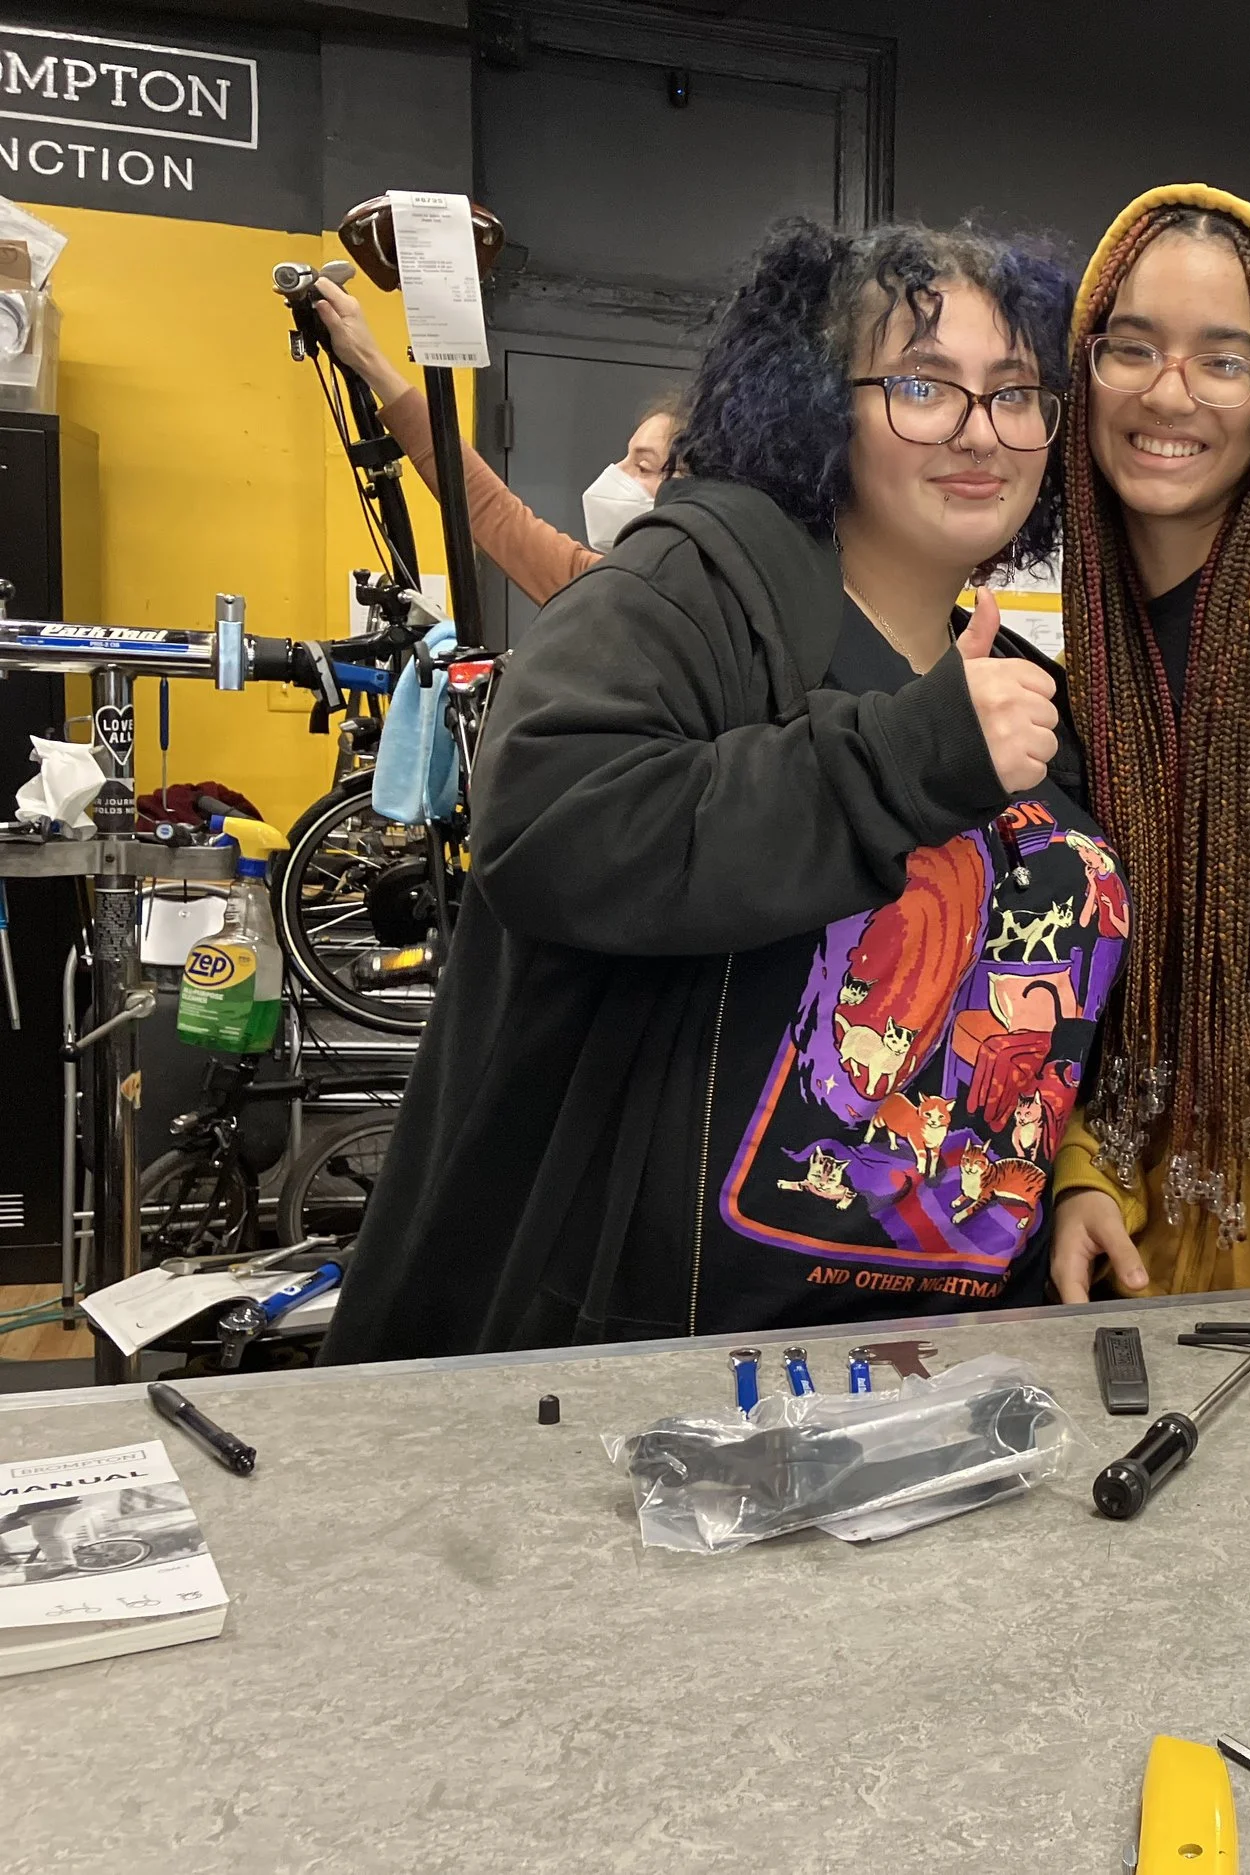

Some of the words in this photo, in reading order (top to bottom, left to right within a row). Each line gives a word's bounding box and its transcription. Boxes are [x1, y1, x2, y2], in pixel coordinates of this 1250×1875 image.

[0, 50, 231, 120] MPTON
[40, 624, 107, 639] Park
[108, 628, 168, 642] Tool
[103, 719, 133, 731] LOVE
[109, 732, 132, 744] ALL
[806, 1266, 850, 1285] AND
[855, 1270, 916, 1292] OTHER
[917, 1275, 1005, 1298] NIGHTMA
[20, 1454, 136, 1476] BROMPTON
